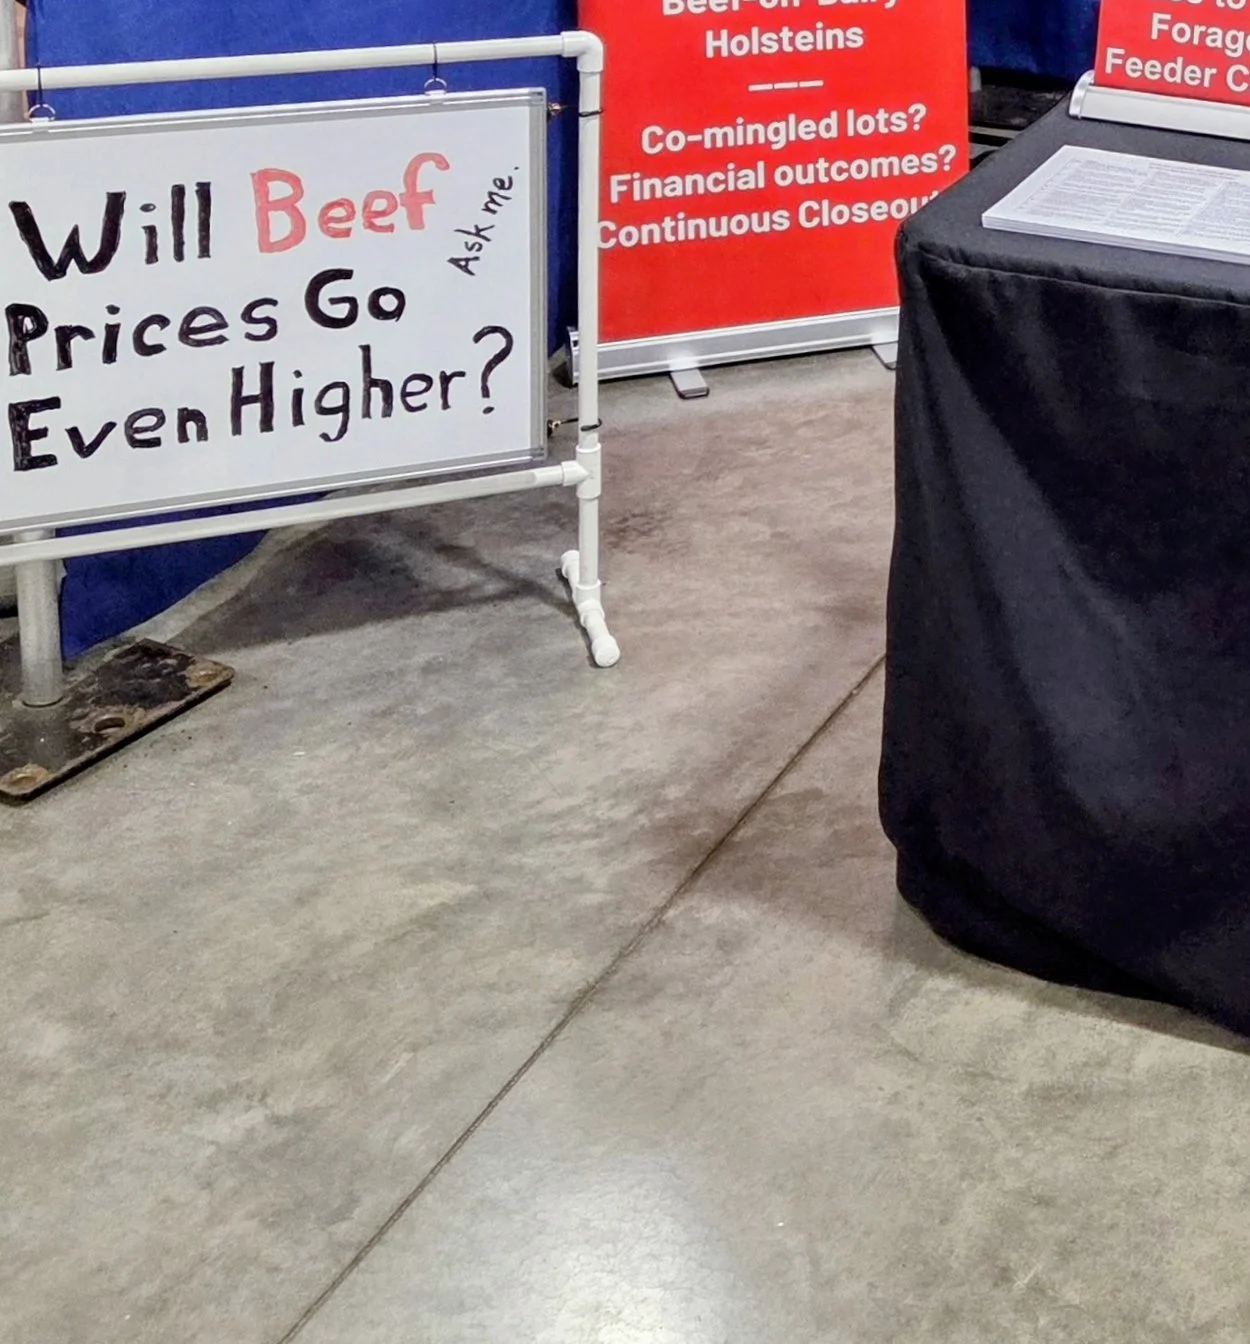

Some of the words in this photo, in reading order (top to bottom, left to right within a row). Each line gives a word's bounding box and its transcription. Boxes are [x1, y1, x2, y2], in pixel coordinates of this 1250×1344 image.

[705, 21, 864, 58] Holsteins
[1105, 48, 1217, 88] Feeder
[641, 109, 838, 155] Co-mingled
[846, 102, 927, 139] lots?
[609, 161, 766, 204] Financial
[774, 144, 957, 188] outcomes?
[8, 181, 213, 281] Will
[250, 152, 450, 254] Beef
[446, 221, 496, 277] Ask
[480, 163, 521, 222] me.
[597, 207, 790, 250] Continuous
[4, 297, 280, 377] Prices
[304, 268, 407, 329] Go
[8, 396, 210, 472] Even
[230, 324, 515, 443] Higher?
